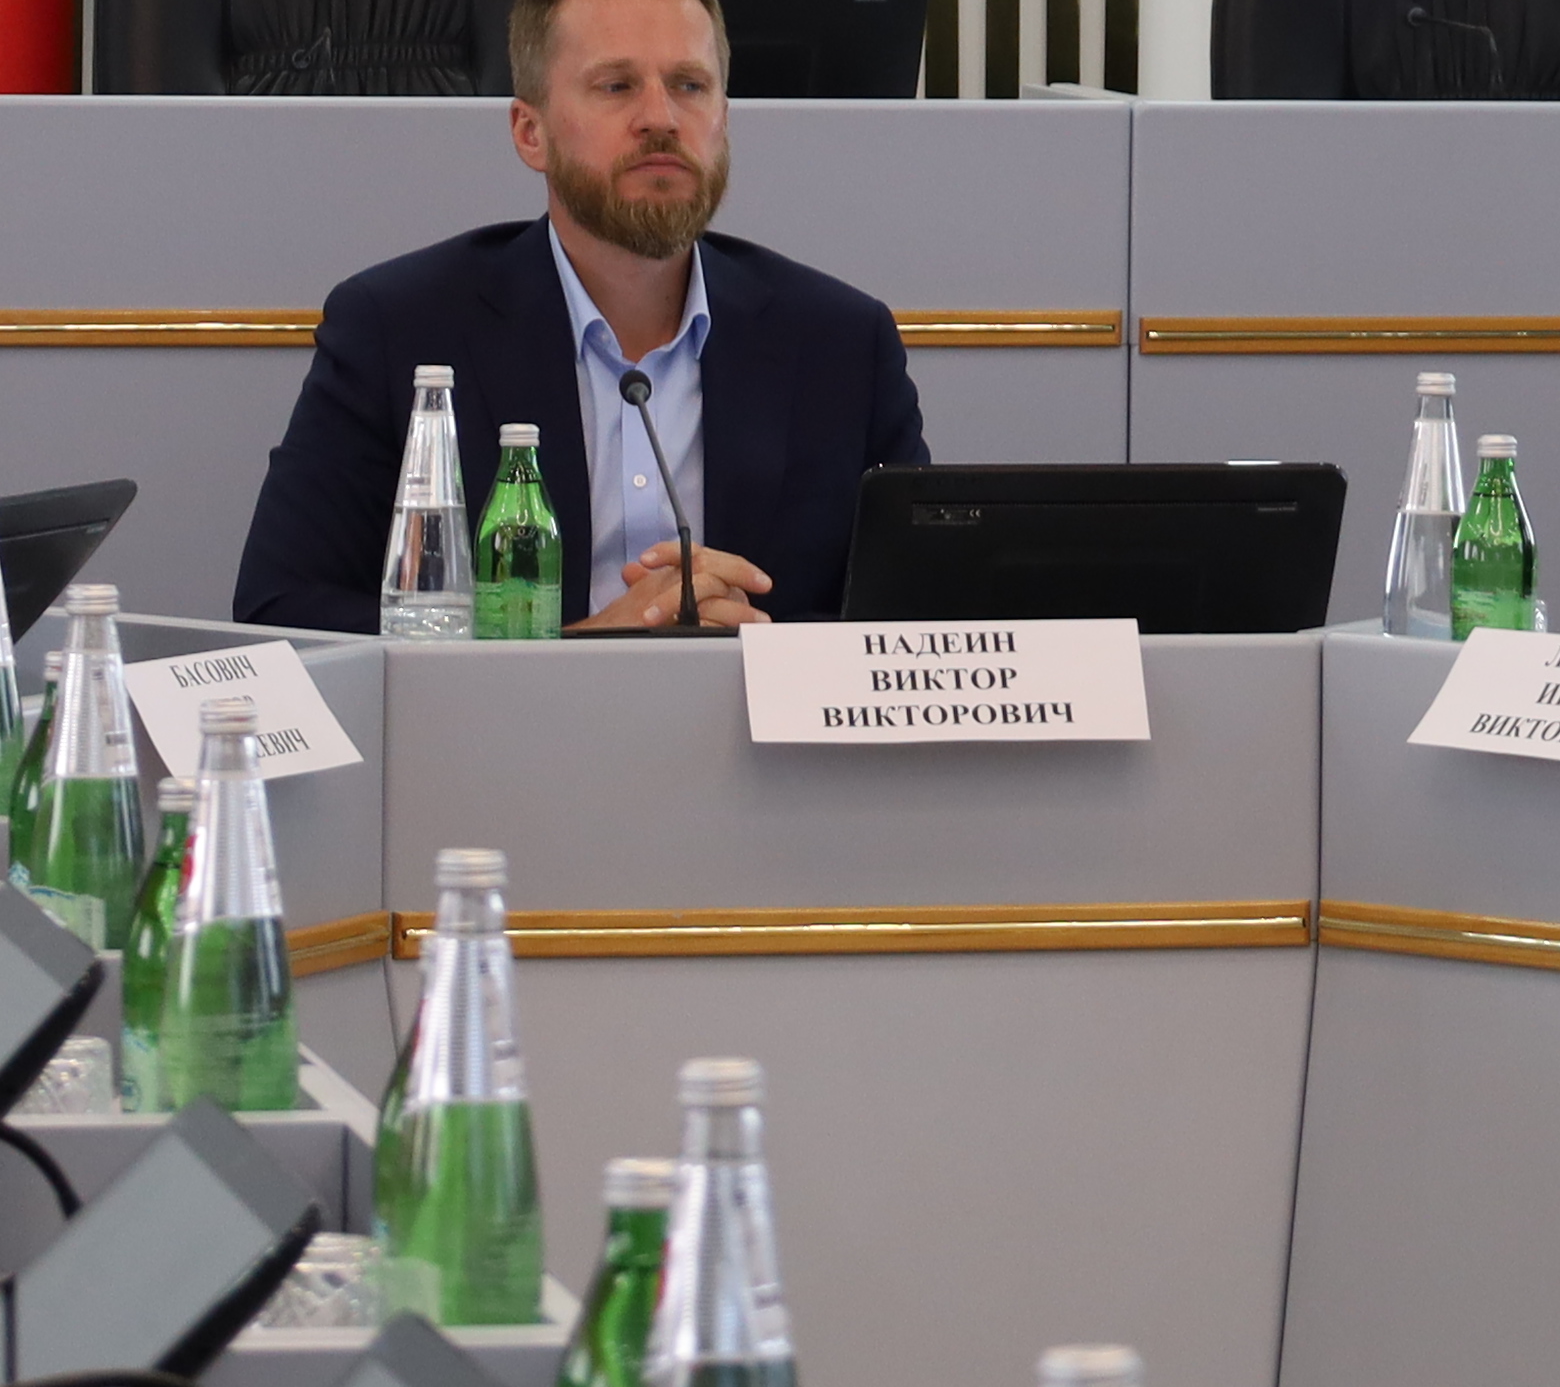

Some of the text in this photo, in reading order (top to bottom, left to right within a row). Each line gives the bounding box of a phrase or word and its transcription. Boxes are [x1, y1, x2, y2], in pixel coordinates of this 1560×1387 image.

[863, 631, 1017, 658] НАДЕИН
[169, 654, 259, 688] БАСОВИЧ
[870, 667, 1018, 692] ВИКТОР
[822, 702, 1076, 727] ВИКТОРОВИЧ
